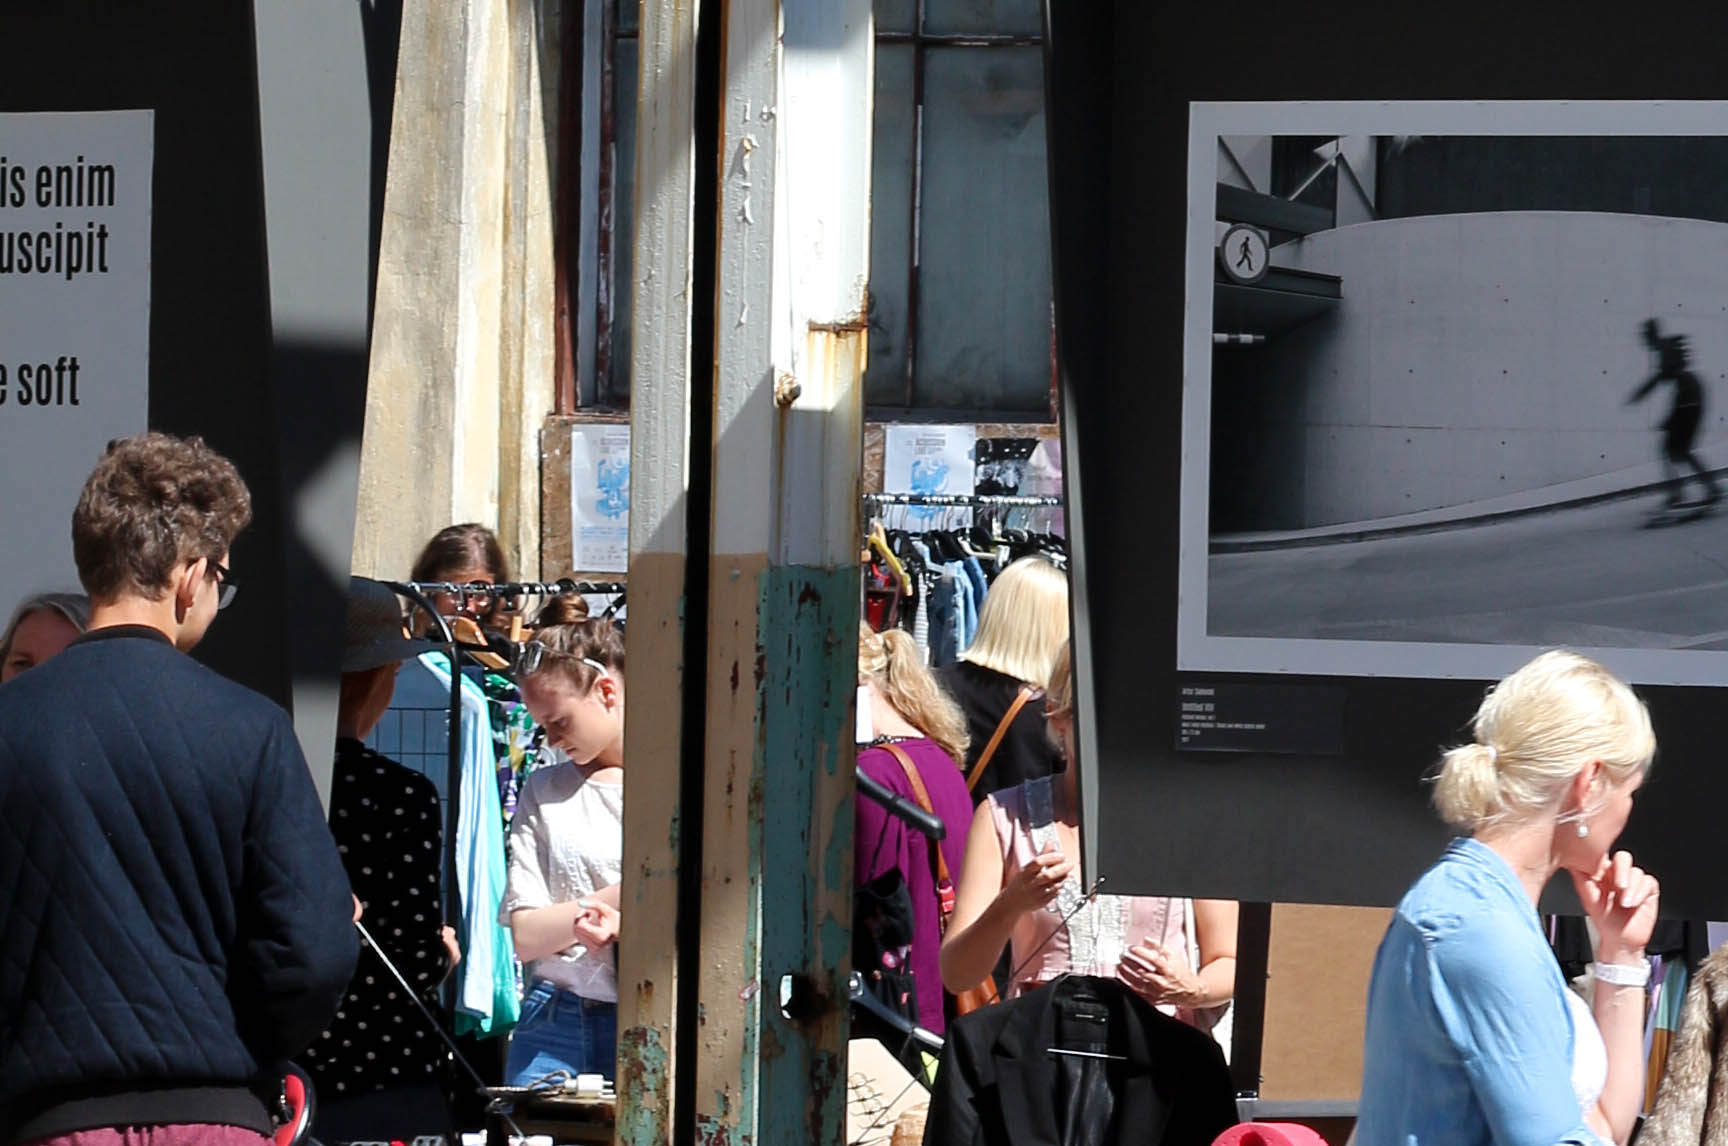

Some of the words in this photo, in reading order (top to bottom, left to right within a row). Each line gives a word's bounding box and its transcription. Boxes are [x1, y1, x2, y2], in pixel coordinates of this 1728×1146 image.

[0, 157, 26, 208] is
[35, 155, 116, 208] enim
[0, 222, 109, 281] uscipit
[17, 356, 80, 407] soft
